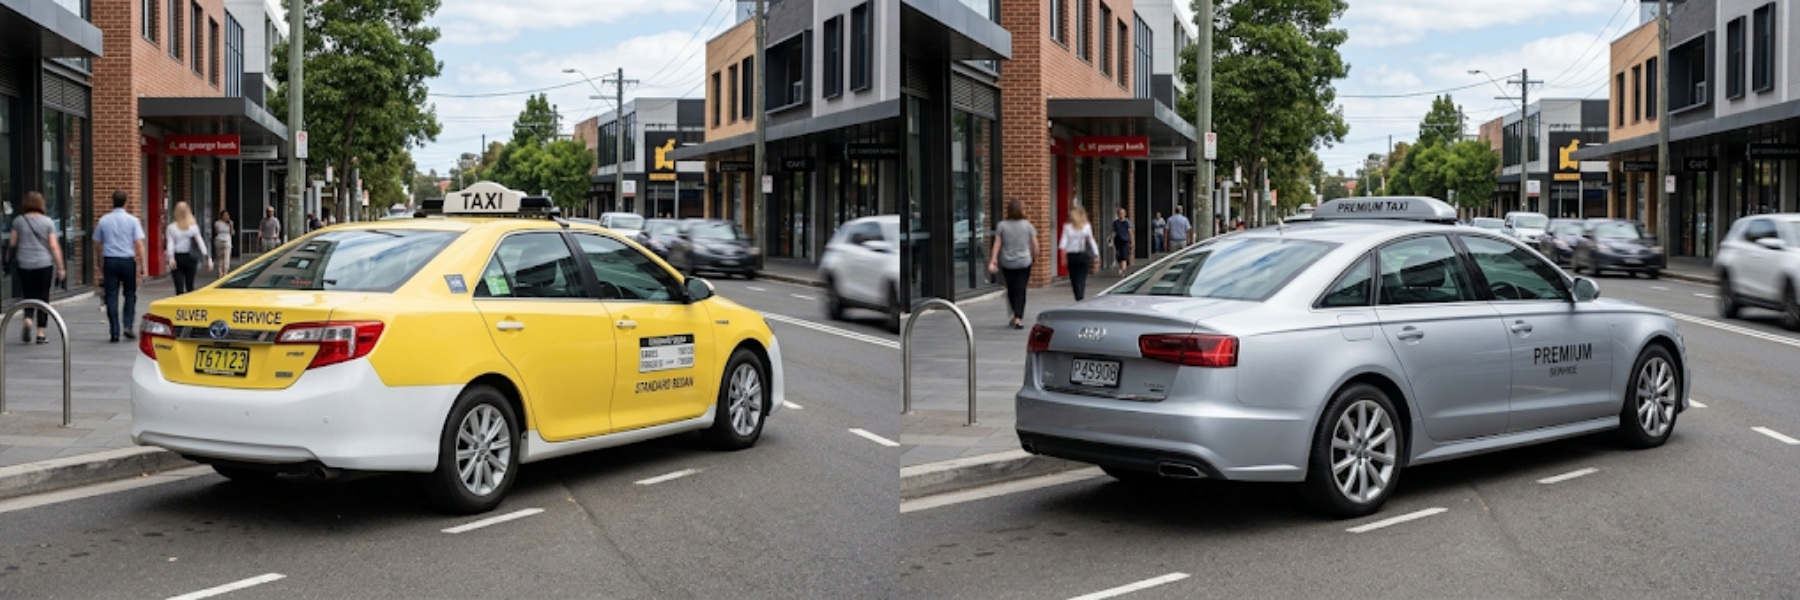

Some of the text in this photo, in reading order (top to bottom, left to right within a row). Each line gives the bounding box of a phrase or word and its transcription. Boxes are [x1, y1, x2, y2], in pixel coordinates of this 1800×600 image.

[461, 193, 503, 209] TAXI
[1337, 201, 1409, 213] PREMIUM TAXI
[175, 309, 282, 325] SILVER SERVICE
[198, 350, 247, 370] T67123
[1534, 343, 1592, 365] PREMIUM
